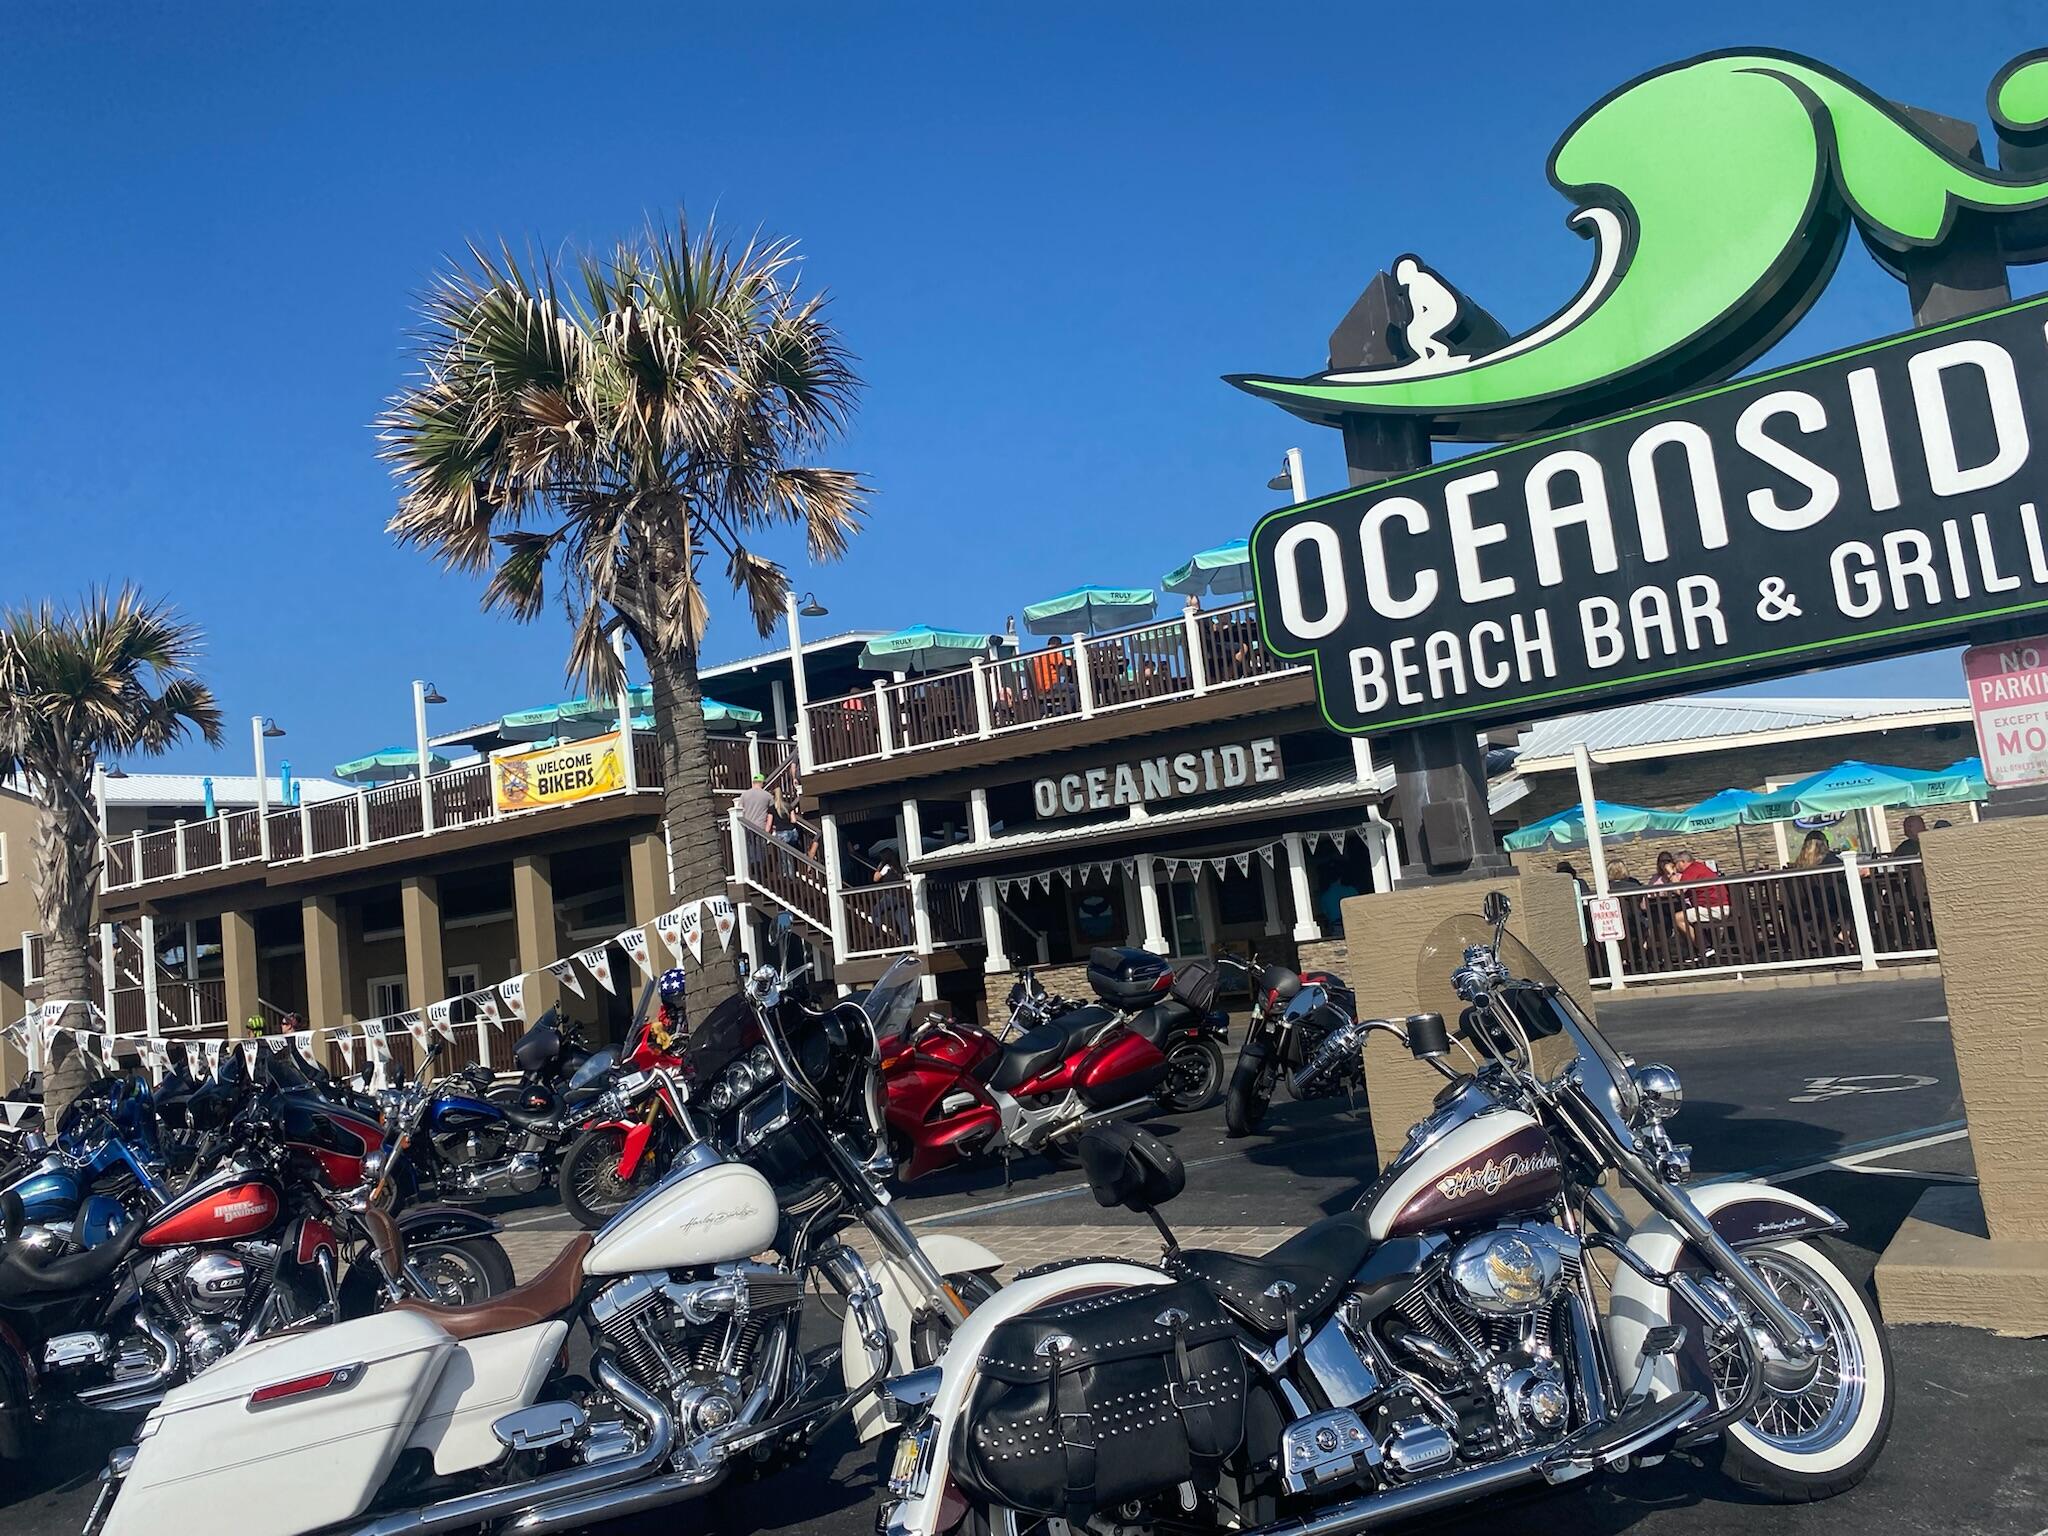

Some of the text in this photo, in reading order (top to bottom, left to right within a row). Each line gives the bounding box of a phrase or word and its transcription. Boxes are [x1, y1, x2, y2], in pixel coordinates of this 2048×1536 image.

[1273, 320, 2048, 640] OCEANSID
[1110, 592, 1132, 600] TRULY
[891, 638, 912, 646] TRULY
[1348, 607, 1558, 715] BEACH
[1581, 573, 1729, 671] BAR
[1757, 576, 1801, 622] &
[2000, 648, 2040, 673] NO
[1994, 712, 2039, 727] EXCEPT
[537, 753, 592, 775] WELCOME
[538, 768, 594, 795] BIKERS
[1034, 737, 1280, 817] OCEANSIDE
[1825, 778, 1874, 787] TRULY
[1928, 782, 1947, 792] TRULY
[1690, 817, 1716, 827] TRULY
[1600, 902, 1611, 910] NO
[658, 913, 679, 931] Lite
[682, 911, 698, 933] Lite
[623, 932, 644, 951] Lite
[584, 949, 604, 968] Lite
[549, 961, 568, 975] Lite
[503, 982, 520, 999] Lite
[472, 991, 493, 1005] Lite
[44, 1004, 62, 1016] Lite
[430, 1007, 447, 1021] Lite
[402, 1013, 420, 1025] Lite
[335, 1030, 350, 1040] Lite
[366, 1024, 382, 1037] Lite
[207, 1043, 218, 1056] Lite
[243, 1040, 256, 1052] Lite
[270, 1038, 285, 1052] Lite
[298, 1036, 310, 1049] Lite
[1445, 1148, 1561, 1199] Harley Davidson
[224, 1203, 268, 1223] DAVIDSON
